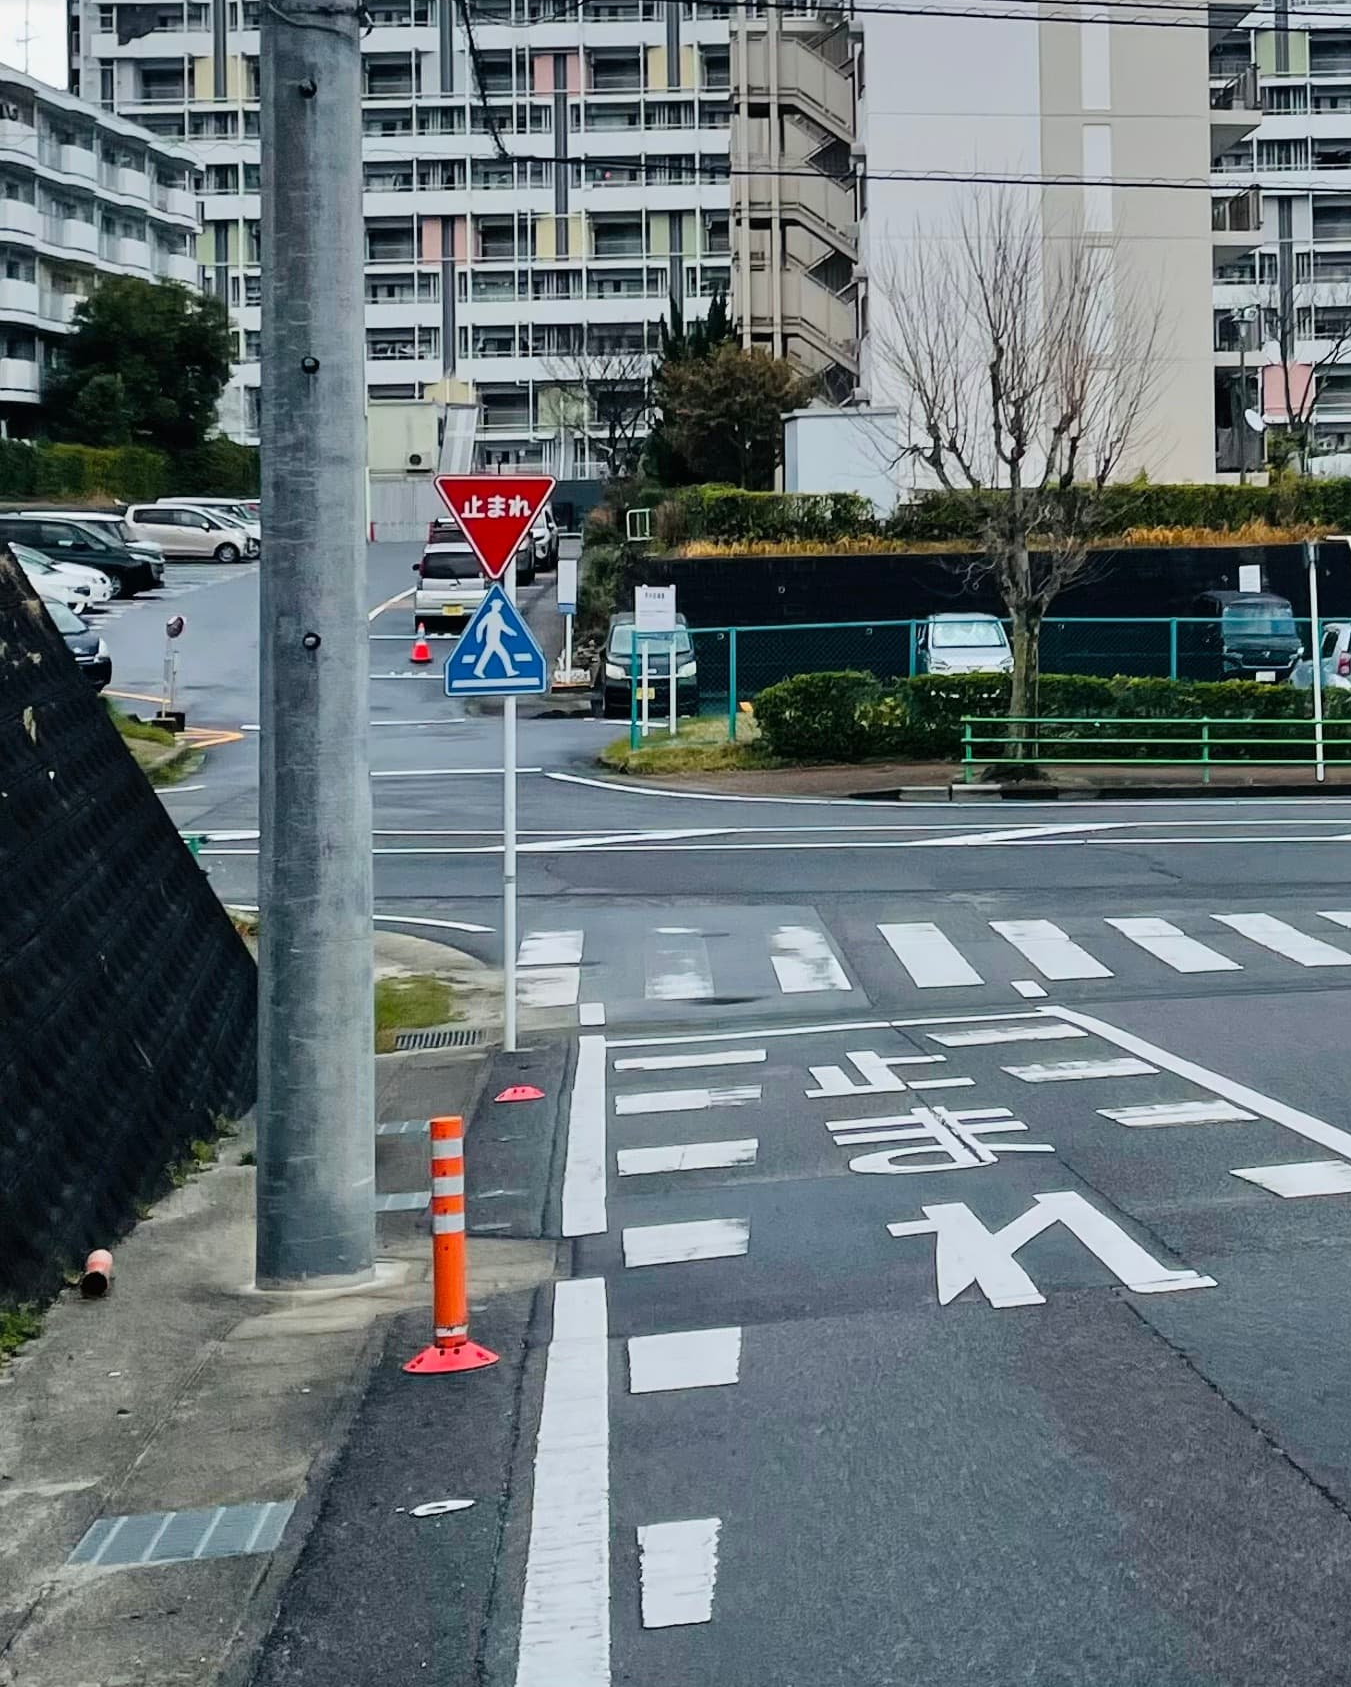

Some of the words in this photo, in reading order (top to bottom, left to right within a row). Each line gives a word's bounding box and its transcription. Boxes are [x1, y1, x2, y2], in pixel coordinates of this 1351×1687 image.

[461, 495, 531, 518] 止まれ
[806, 1050, 1218, 1309] 止まれ
